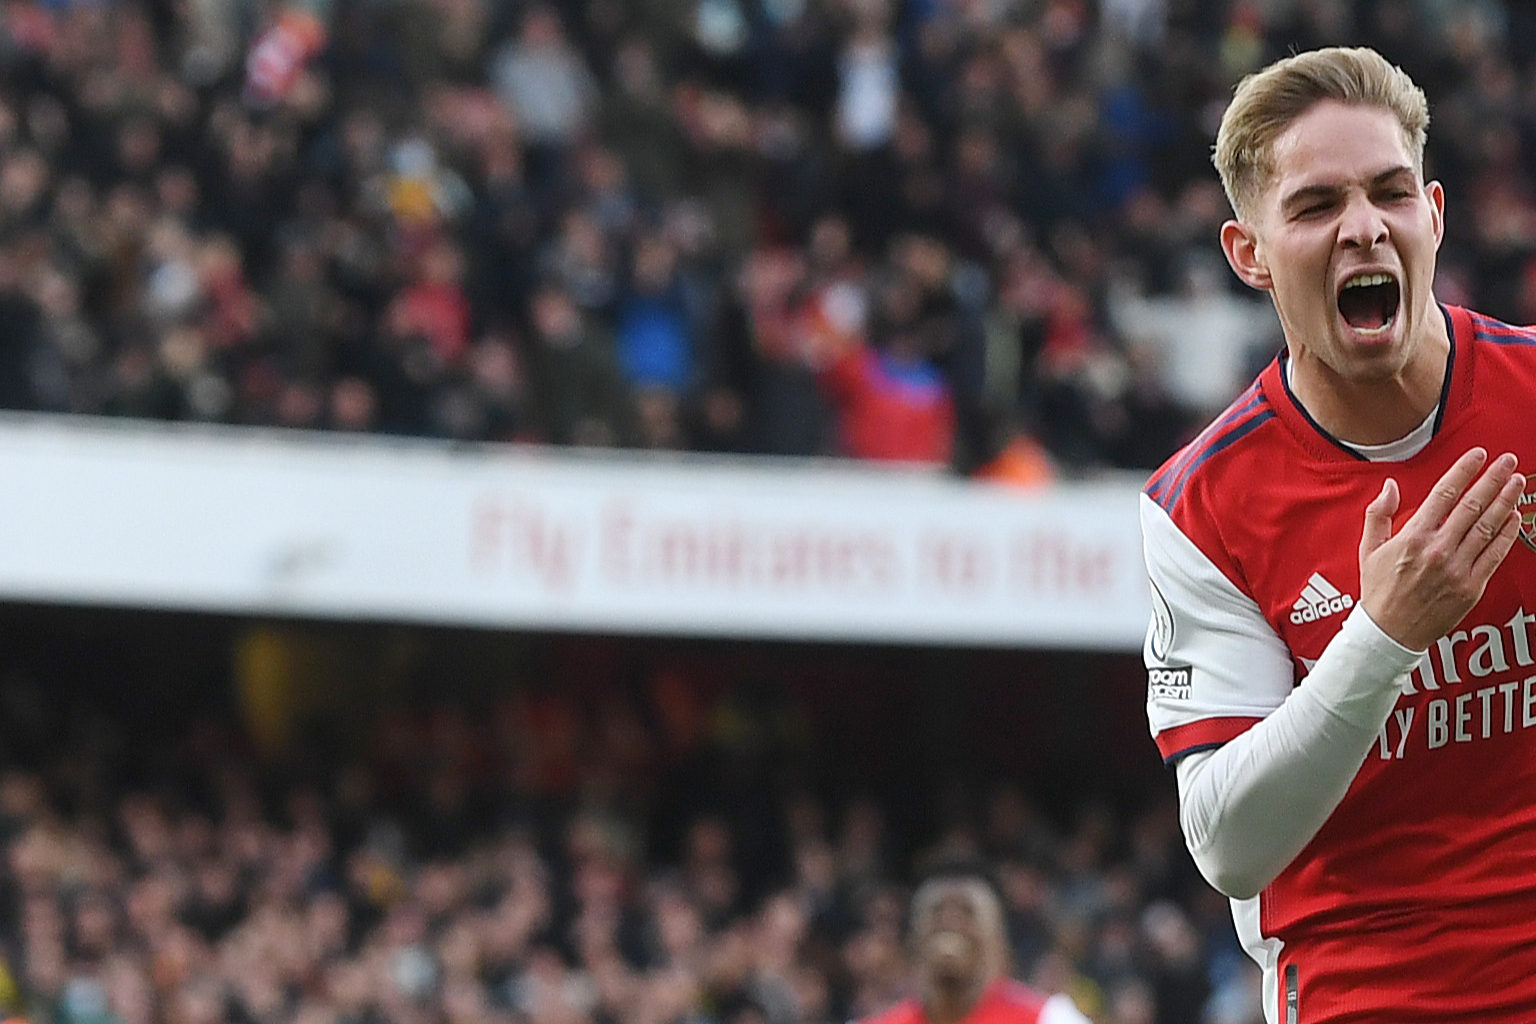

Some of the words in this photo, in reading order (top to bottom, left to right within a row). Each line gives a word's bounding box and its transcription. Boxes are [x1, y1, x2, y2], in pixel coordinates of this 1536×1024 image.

[1289, 593, 1354, 625] adidas
[1149, 669, 1189, 686] oom
[1379, 706, 1415, 760] LY
